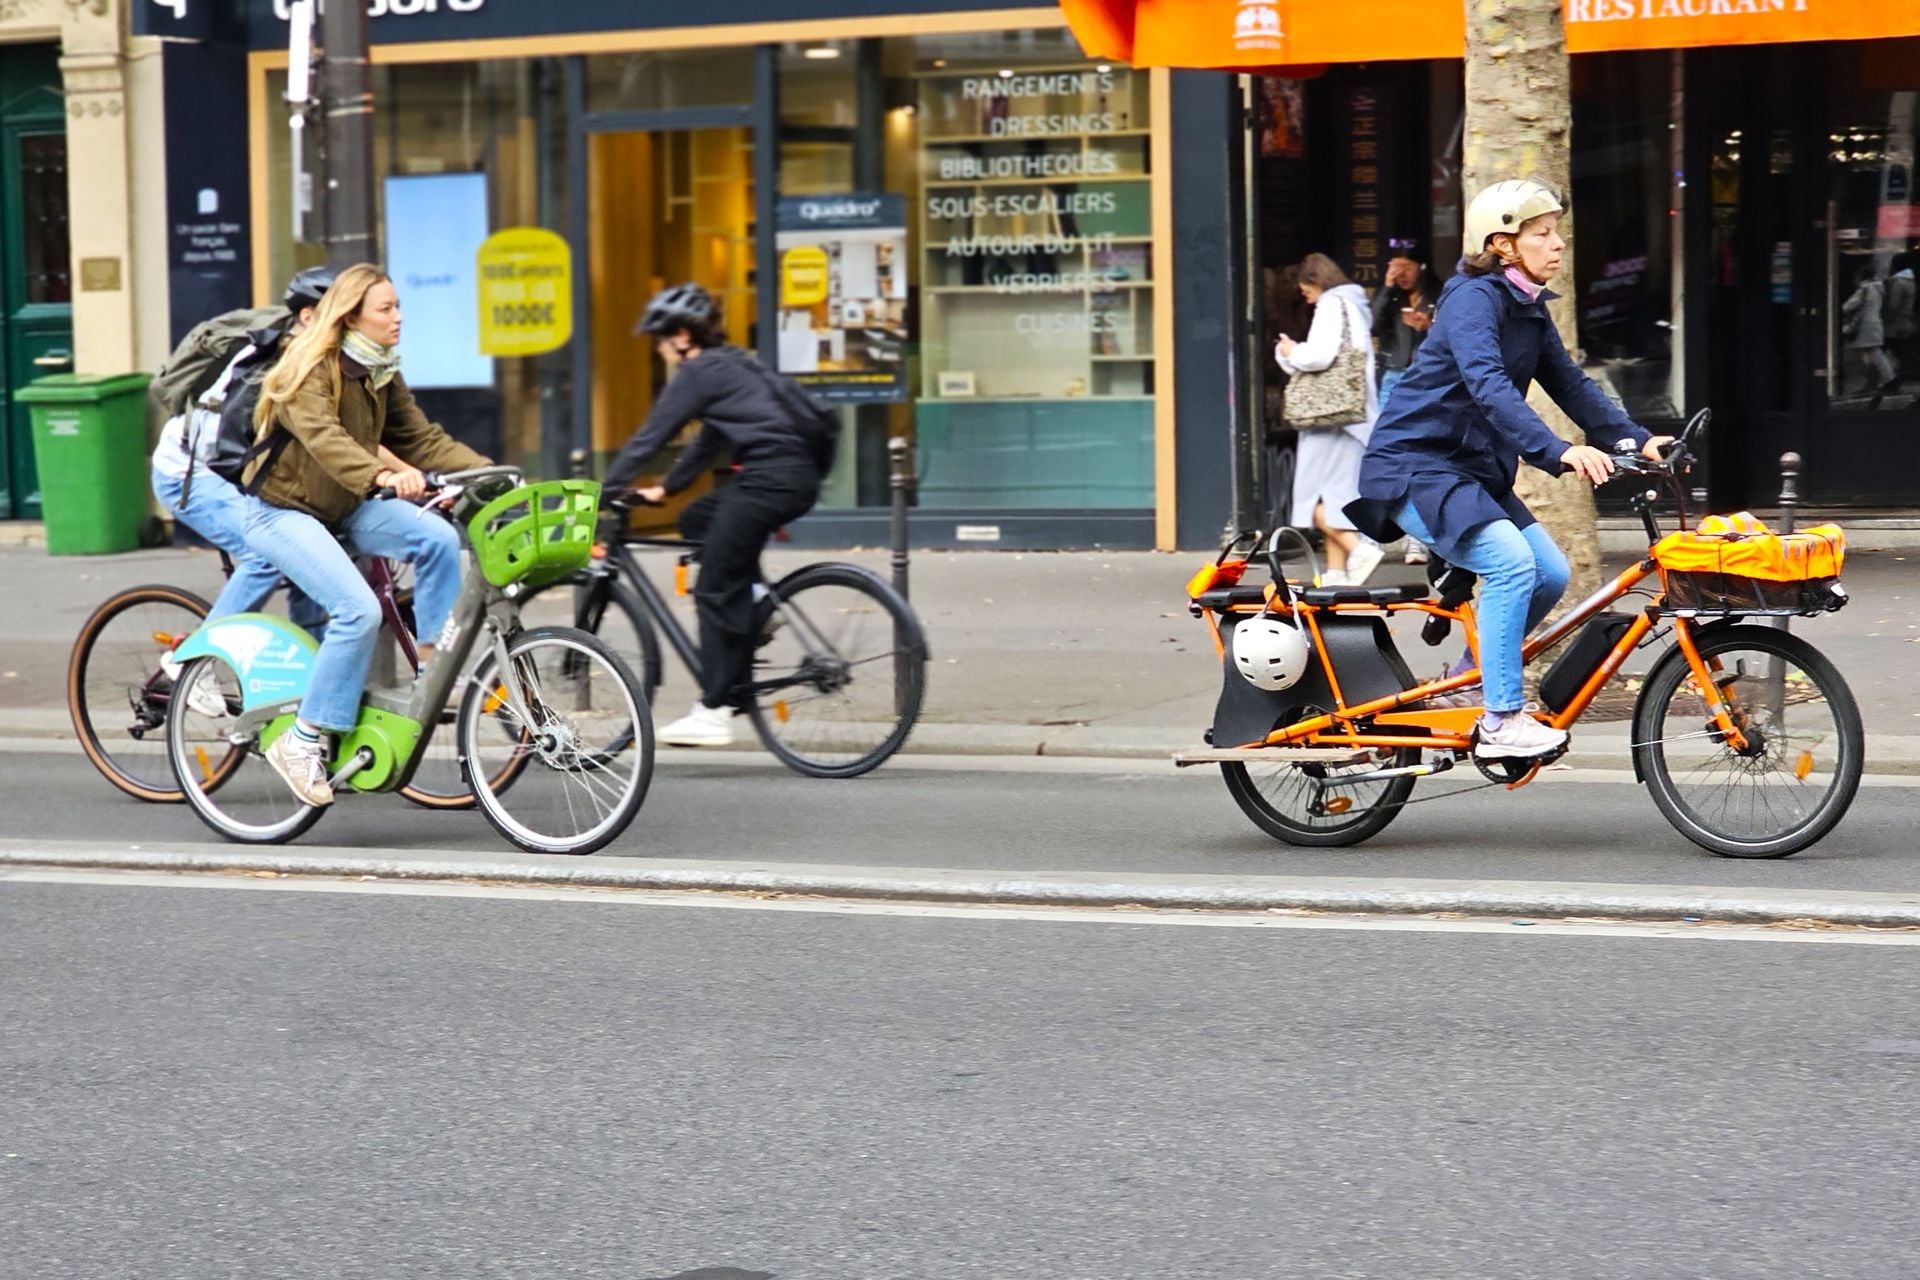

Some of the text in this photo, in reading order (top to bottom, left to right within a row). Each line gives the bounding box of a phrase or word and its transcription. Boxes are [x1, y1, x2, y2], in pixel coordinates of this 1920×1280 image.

[962, 74, 1115, 99] RANGEMENTS
[990, 112, 1115, 137] DRESSINGS
[928, 192, 1116, 219] SOUS-ESCALIERS
[947, 231, 1115, 257] AUTOUR DU LIT
[493, 303, 555, 326] 1000€
[1015, 311, 1118, 333] CUISINES
